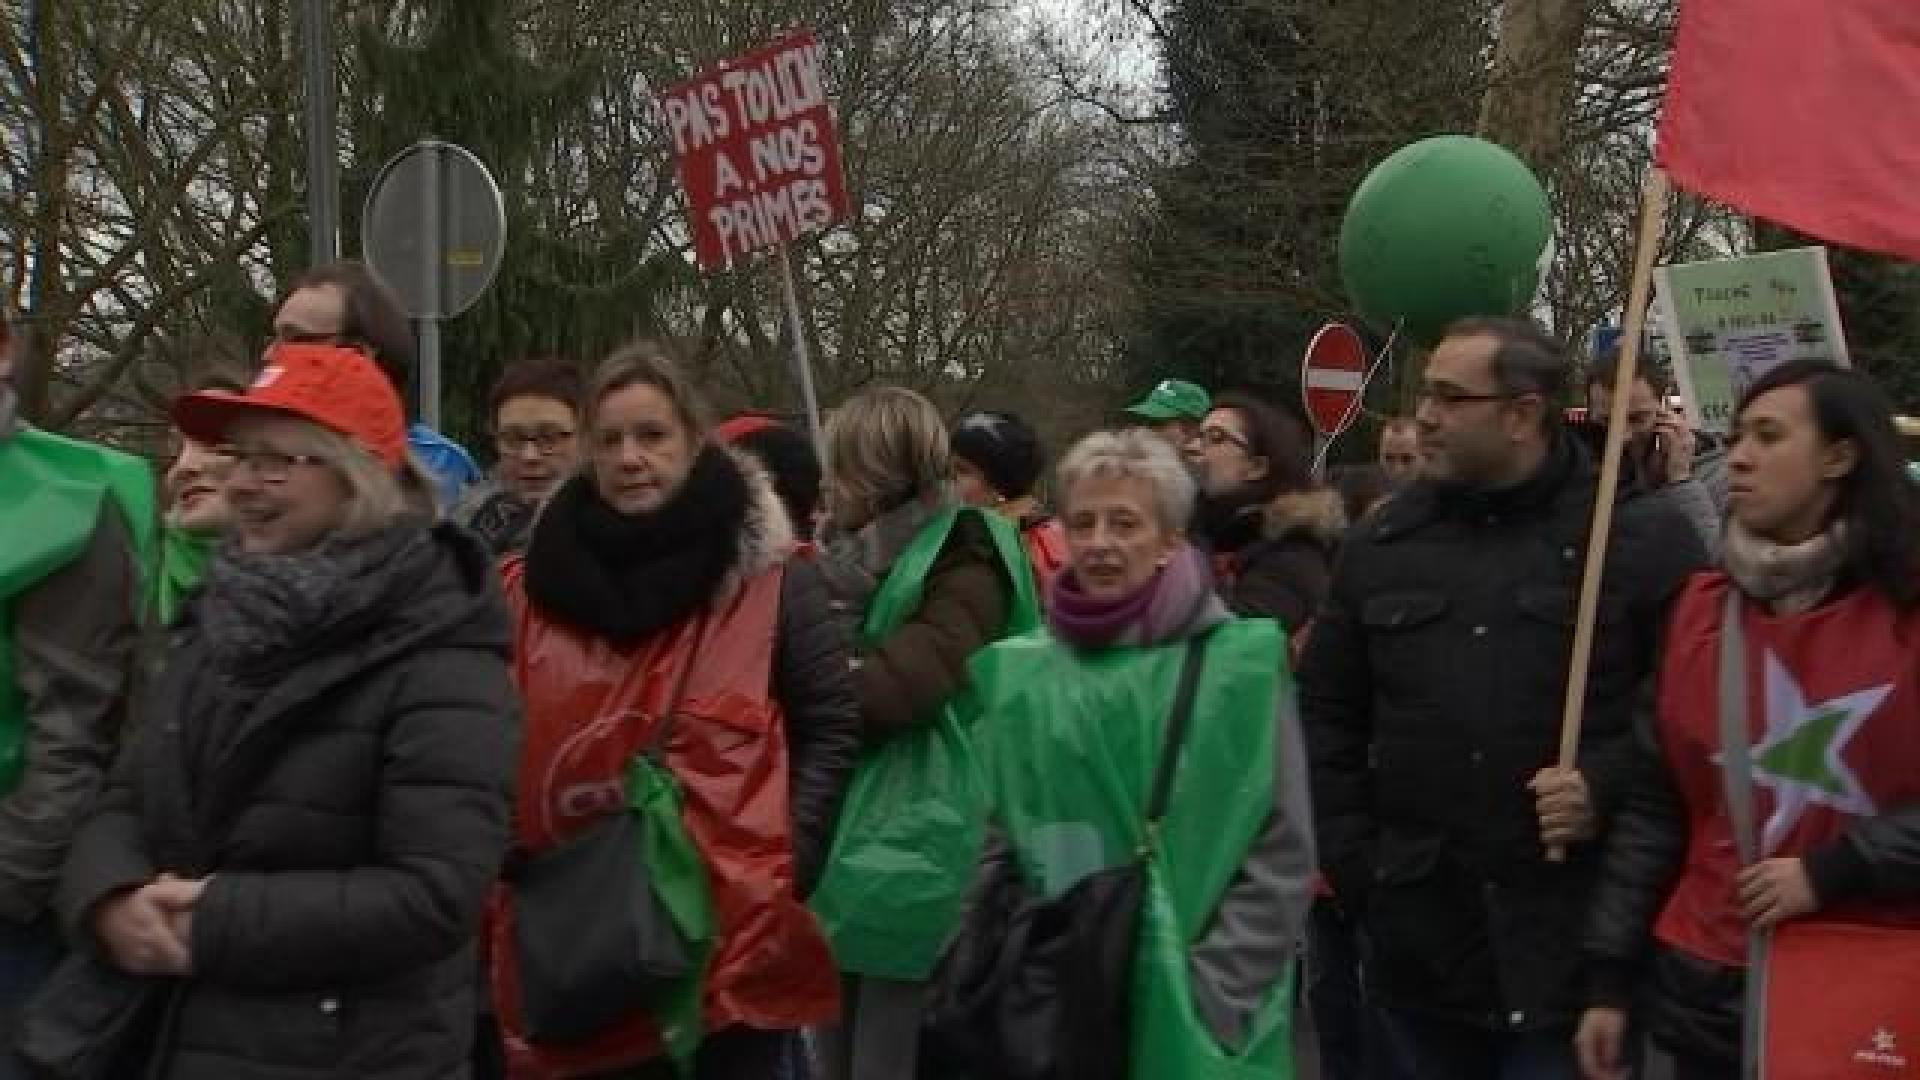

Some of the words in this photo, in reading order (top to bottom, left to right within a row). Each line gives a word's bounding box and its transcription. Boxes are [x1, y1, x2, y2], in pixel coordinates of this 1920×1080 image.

[665, 84, 730, 154] PAS
[750, 119, 826, 183] NOS
[709, 179, 832, 264] PRIMES
